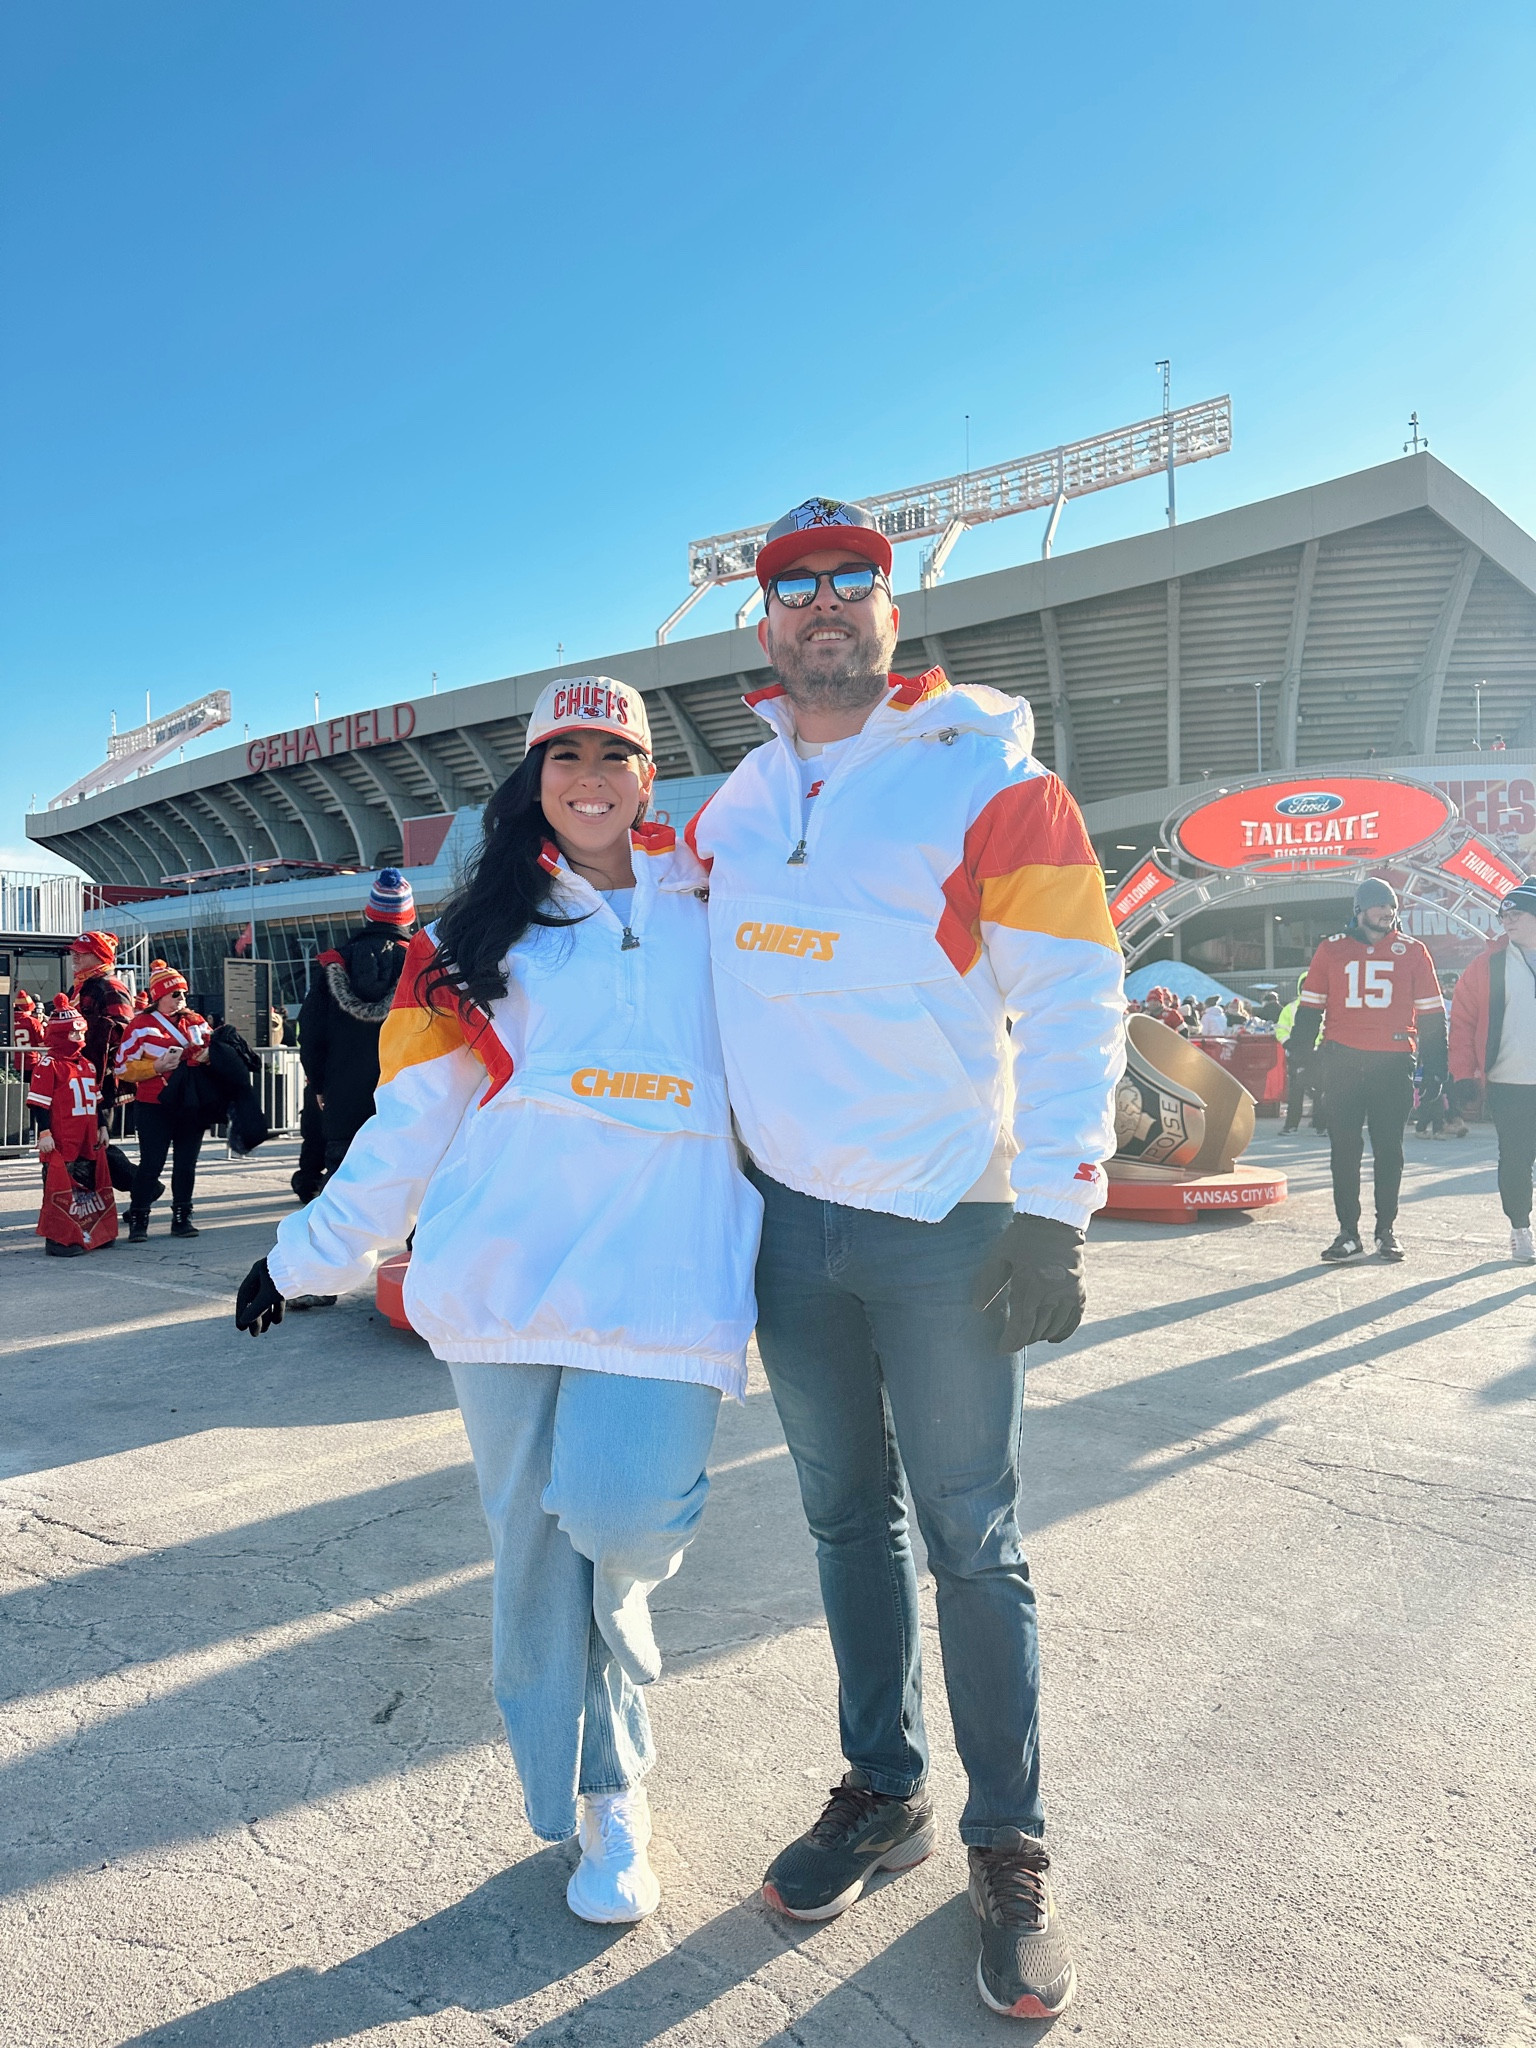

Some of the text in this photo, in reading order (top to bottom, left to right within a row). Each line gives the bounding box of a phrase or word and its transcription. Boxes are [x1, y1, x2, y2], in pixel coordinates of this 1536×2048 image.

[554, 686, 628, 725] CHIEFS
[246, 703, 416, 774] GEHA FIELD
[1287, 796, 1330, 813] Ford
[1240, 811, 1379, 847] TAILGATE
[1461, 851, 1516, 895] THANK YO
[1116, 872, 1160, 915] WELCOME
[735, 921, 841, 962] CHIEFS
[1344, 960, 1395, 1009] 15
[69, 1077, 98, 1117] 15
[570, 1068, 694, 1108] CHIEFS
[1145, 1100, 1182, 1159] POISE
[1183, 1190, 1239, 1204] KANSAS
[1241, 1188, 1262, 1202] CITY
[1264, 1186, 1275, 1200] VS
